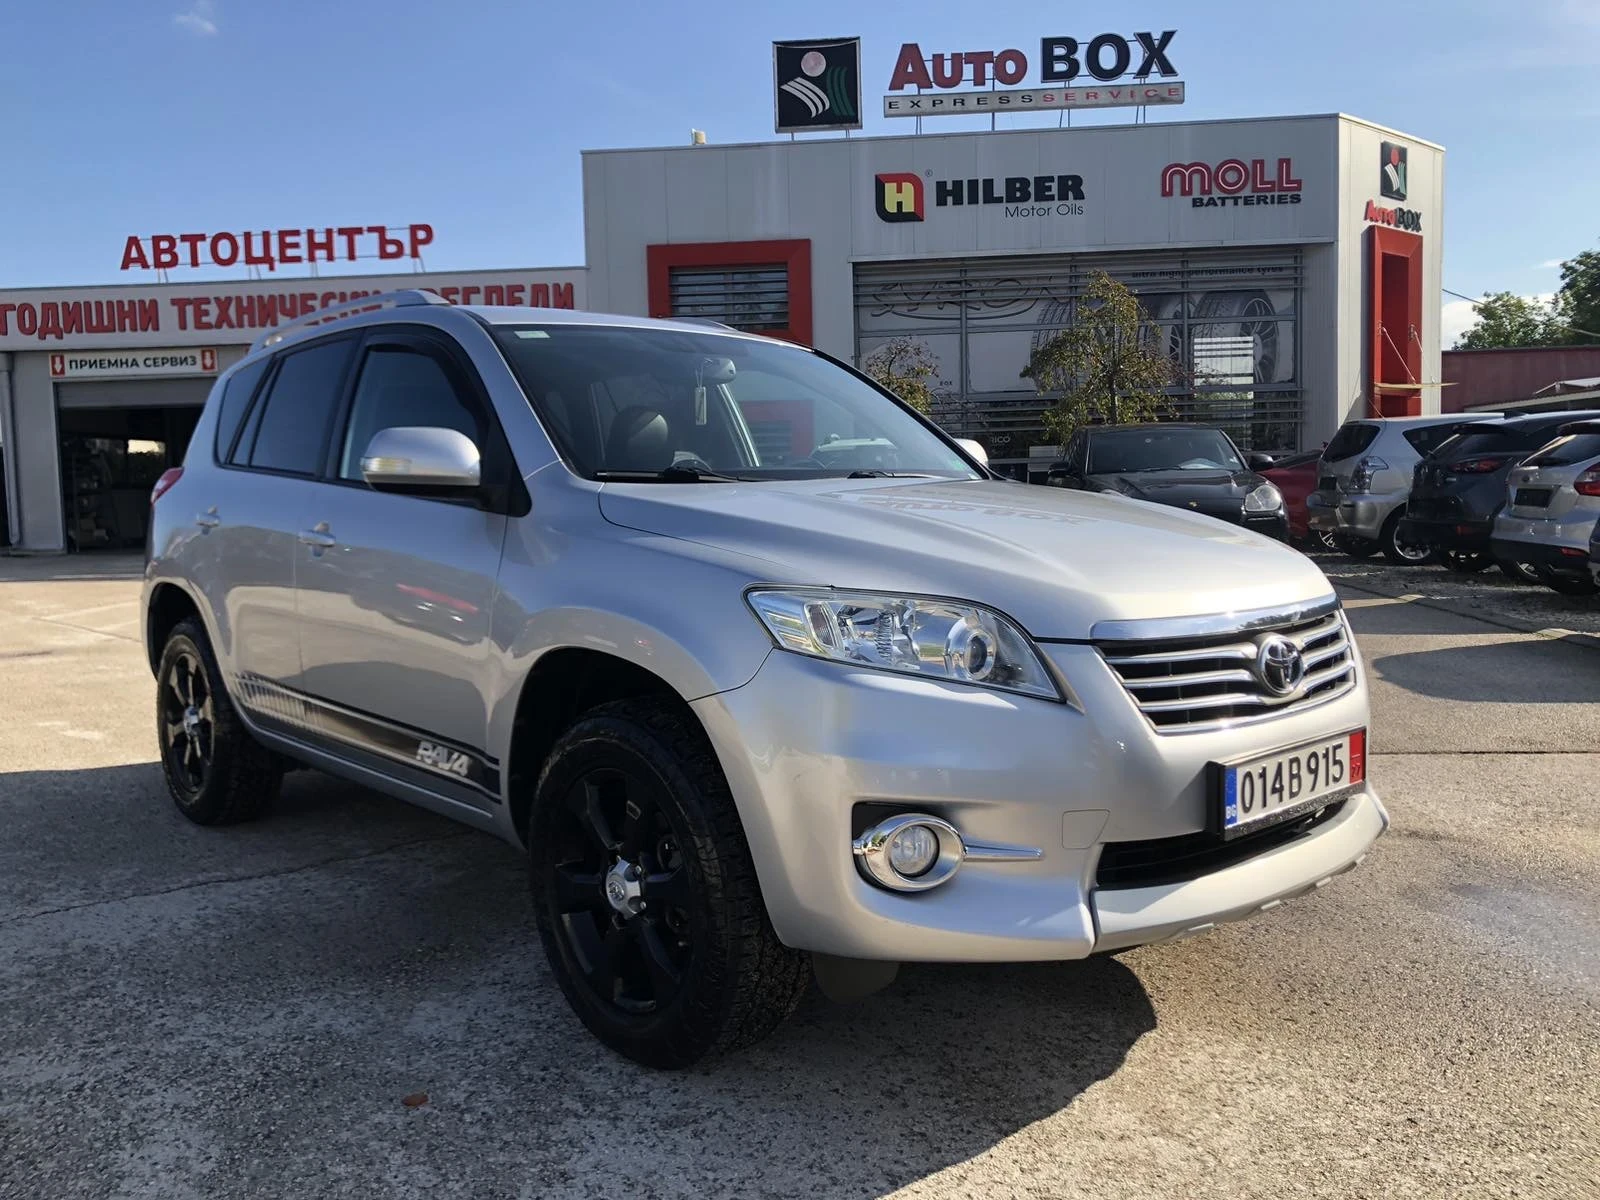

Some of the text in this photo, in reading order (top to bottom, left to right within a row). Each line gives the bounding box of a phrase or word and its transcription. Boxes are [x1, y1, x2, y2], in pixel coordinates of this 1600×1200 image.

[1041, 29, 1179, 84] BOX
[887, 86, 1181, 110] EXPRESS SERVICE
[935, 174, 1086, 207] HILBER
[1192, 193, 1302, 208] BATTERIES
[1004, 203, 1084, 218] Motor Oils
[120, 224, 434, 271] АВТОЦЕНТЪР
[0, 299, 160, 340] ГОДИШНИ
[69, 355, 197, 370] ПРИЕМНА СЕРВИЗ
[415, 740, 470, 776] RAV4
[1241, 742, 1344, 814] 014B915
[1225, 804, 1237, 820] BG
